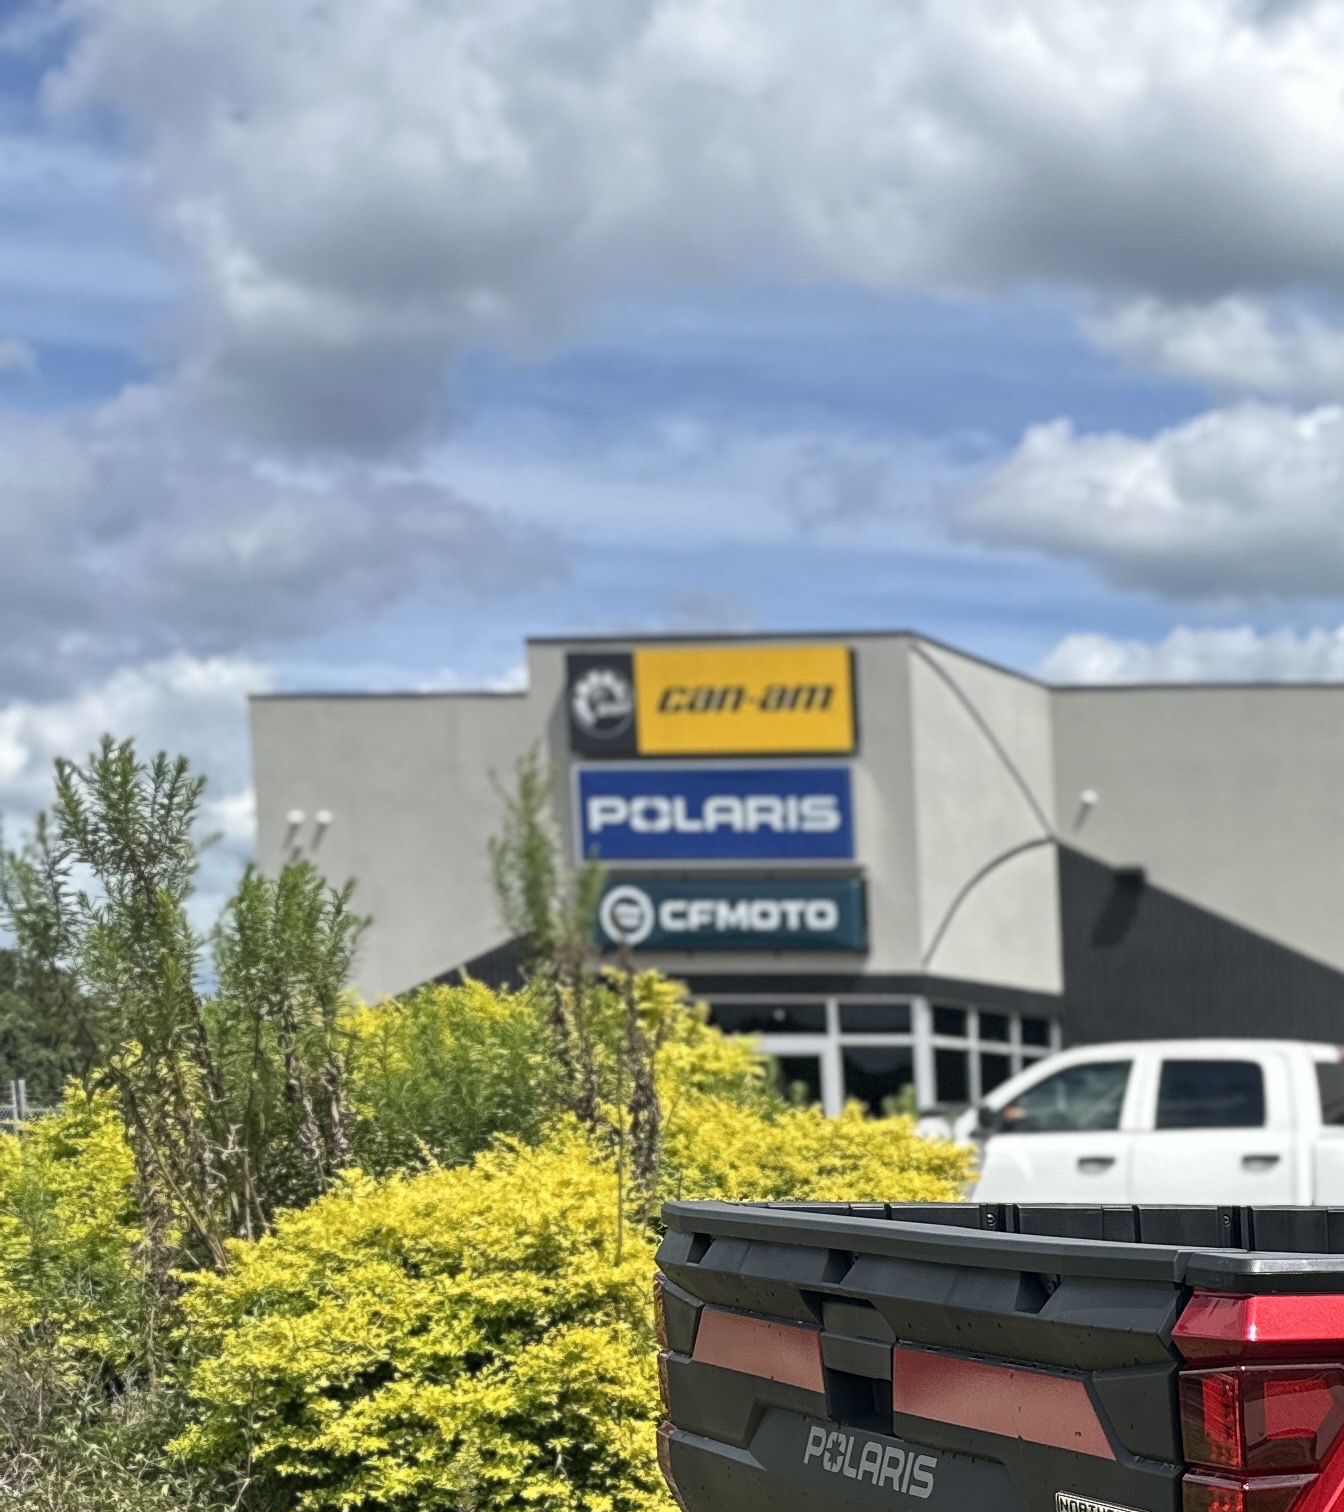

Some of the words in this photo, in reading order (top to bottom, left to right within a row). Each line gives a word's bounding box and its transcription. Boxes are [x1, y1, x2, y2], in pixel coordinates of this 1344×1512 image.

[657, 683, 836, 714] can-am
[587, 794, 841, 833] POLARIS
[659, 899, 839, 932] CFMOTO
[803, 1425, 938, 1499] POLARIS
